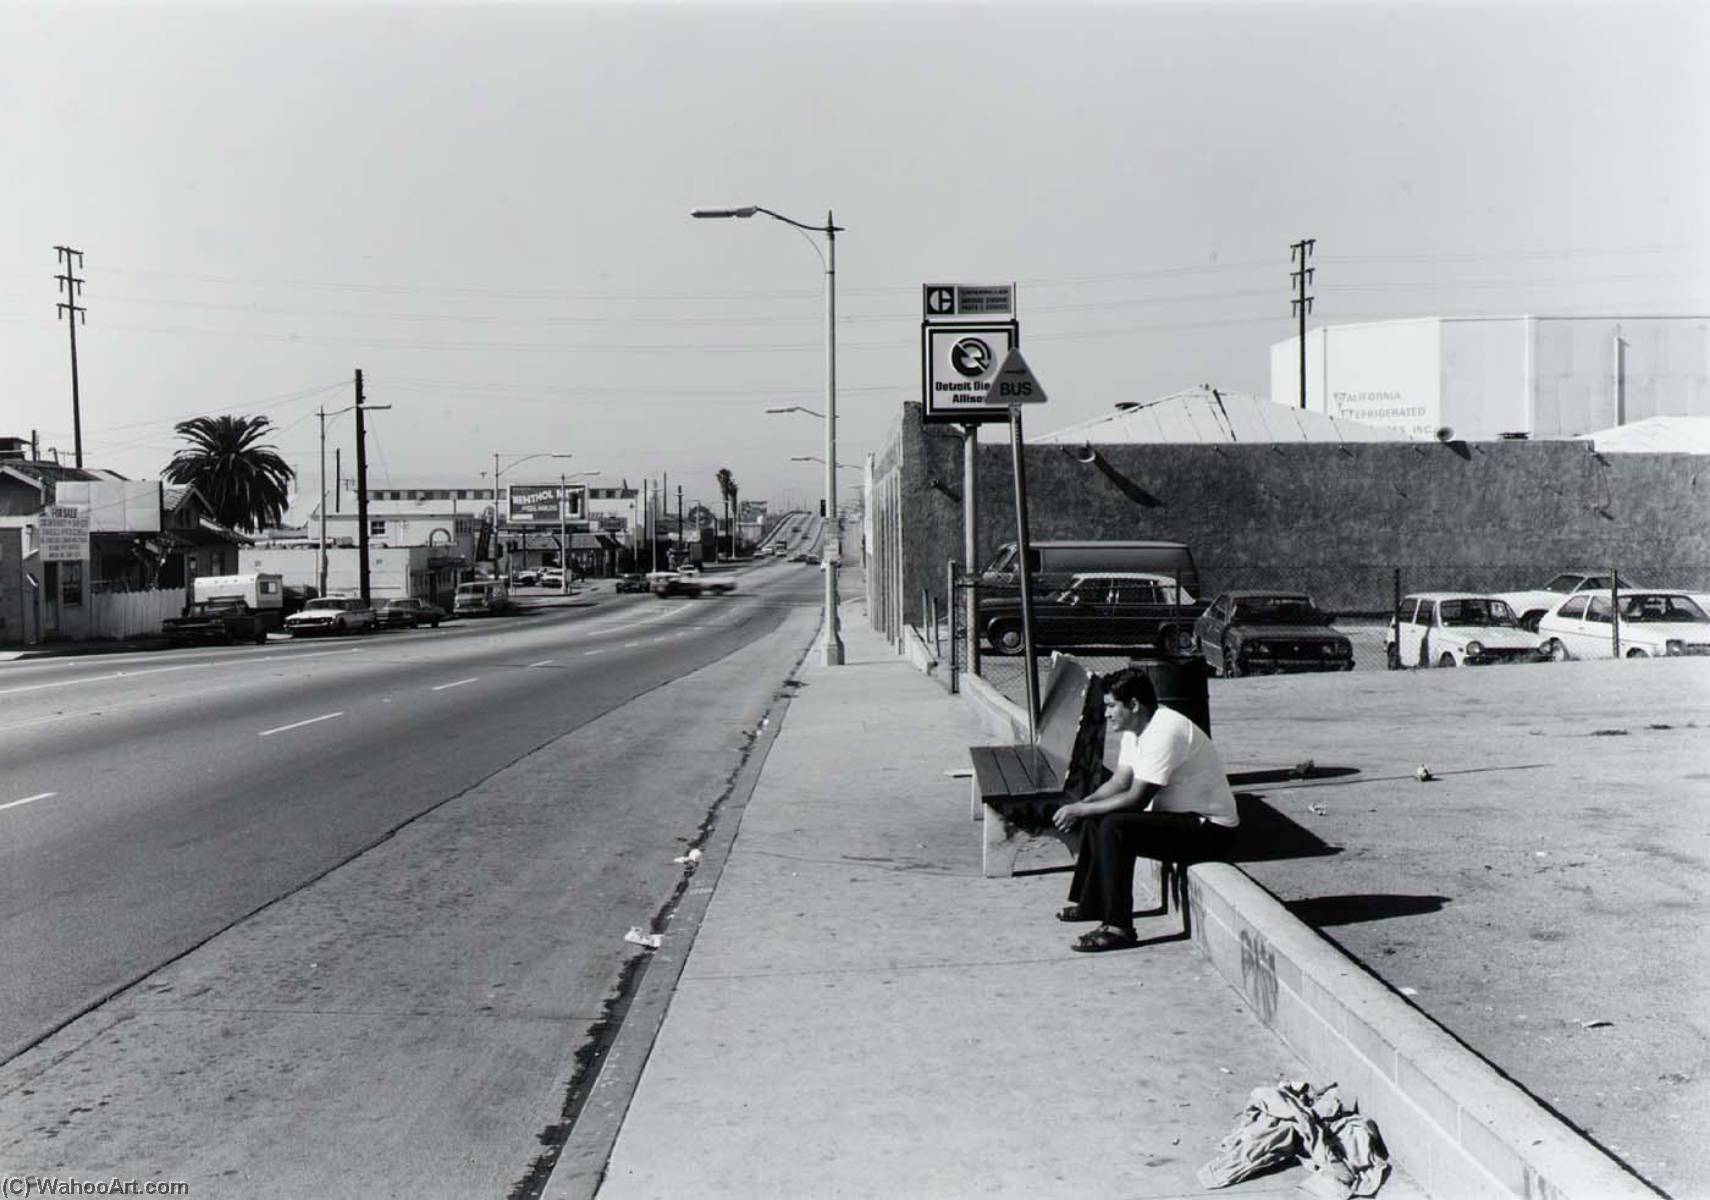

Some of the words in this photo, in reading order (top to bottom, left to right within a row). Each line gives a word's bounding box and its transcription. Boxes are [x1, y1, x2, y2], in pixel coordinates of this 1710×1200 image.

[935, 381, 972, 392] Detroit
[974, 381, 991, 392] Die
[1000, 382, 1033, 396] BUS
[952, 394, 985, 404] Alliso
[63, 508, 78, 518] SALE
